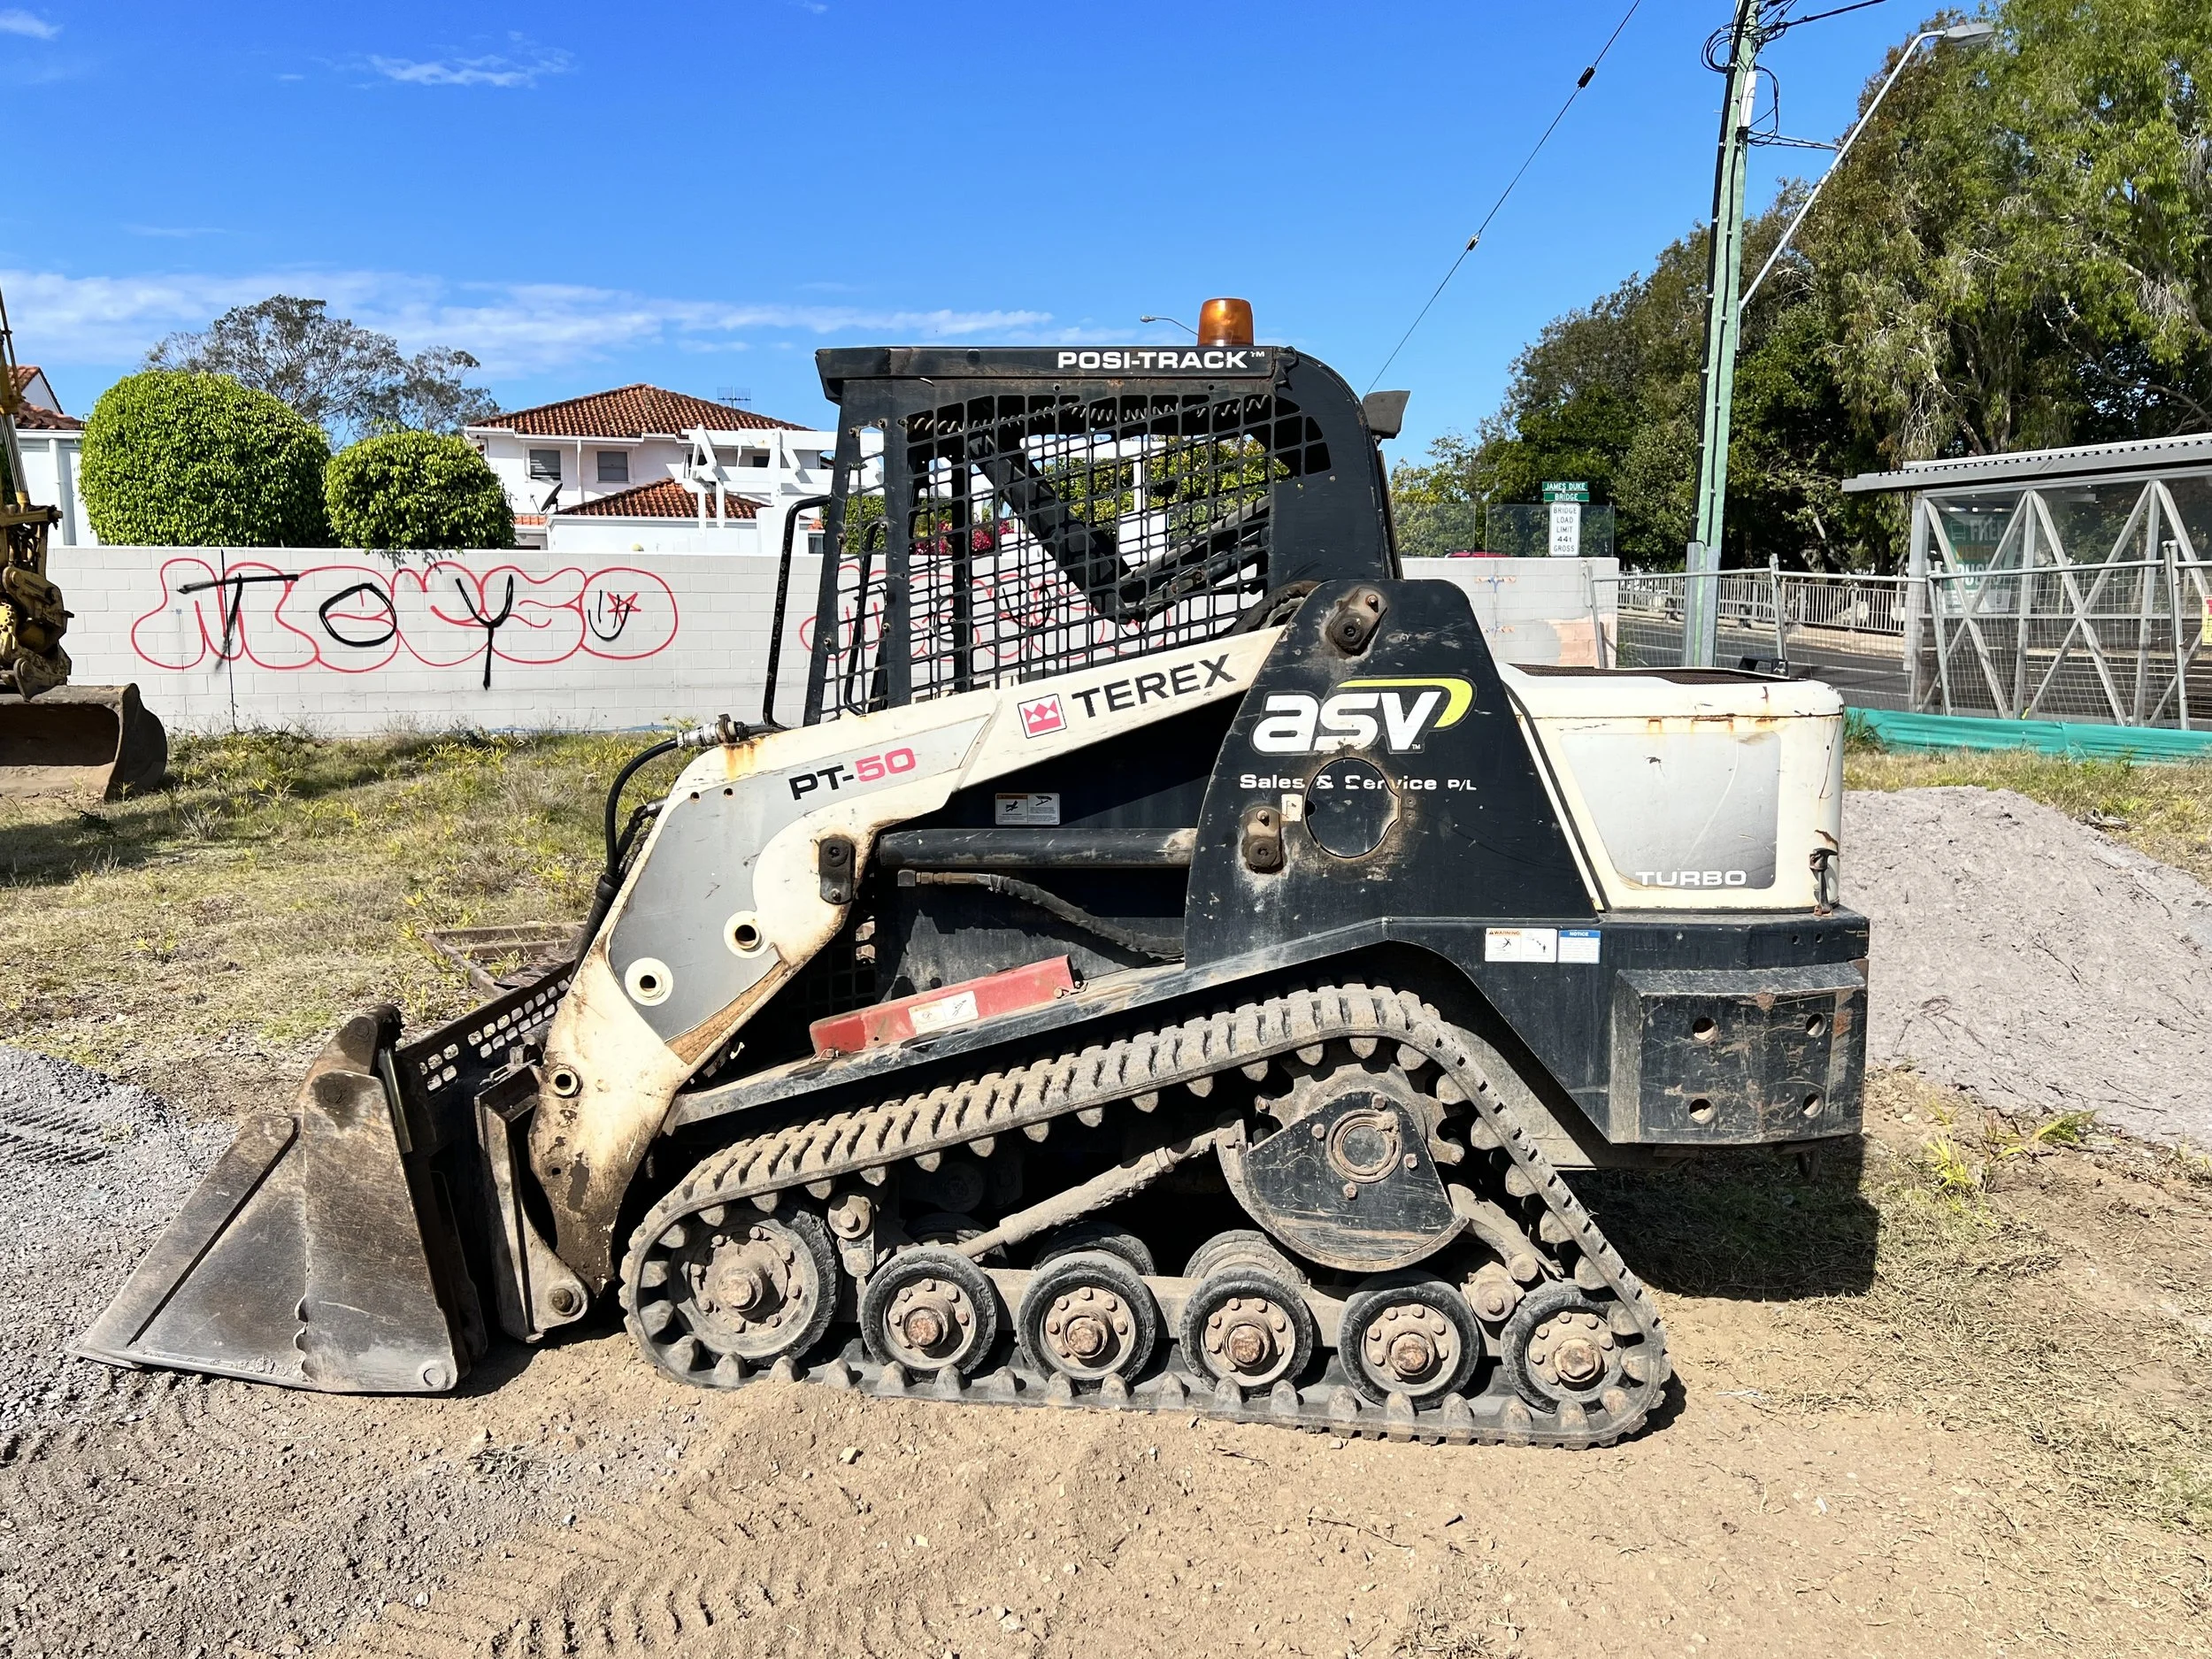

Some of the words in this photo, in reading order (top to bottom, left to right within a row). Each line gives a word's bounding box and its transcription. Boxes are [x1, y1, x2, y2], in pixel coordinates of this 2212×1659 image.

[1057, 351, 1248, 370] POSI-TRACK
[1545, 482, 1567, 491] JAMES
[1071, 653, 1236, 718] TEREX
[788, 748, 916, 801] PT-50
[1240, 774, 1306, 789] Sales
[1448, 780, 1478, 791] P/L
[1635, 870, 1747, 886] TURBO
